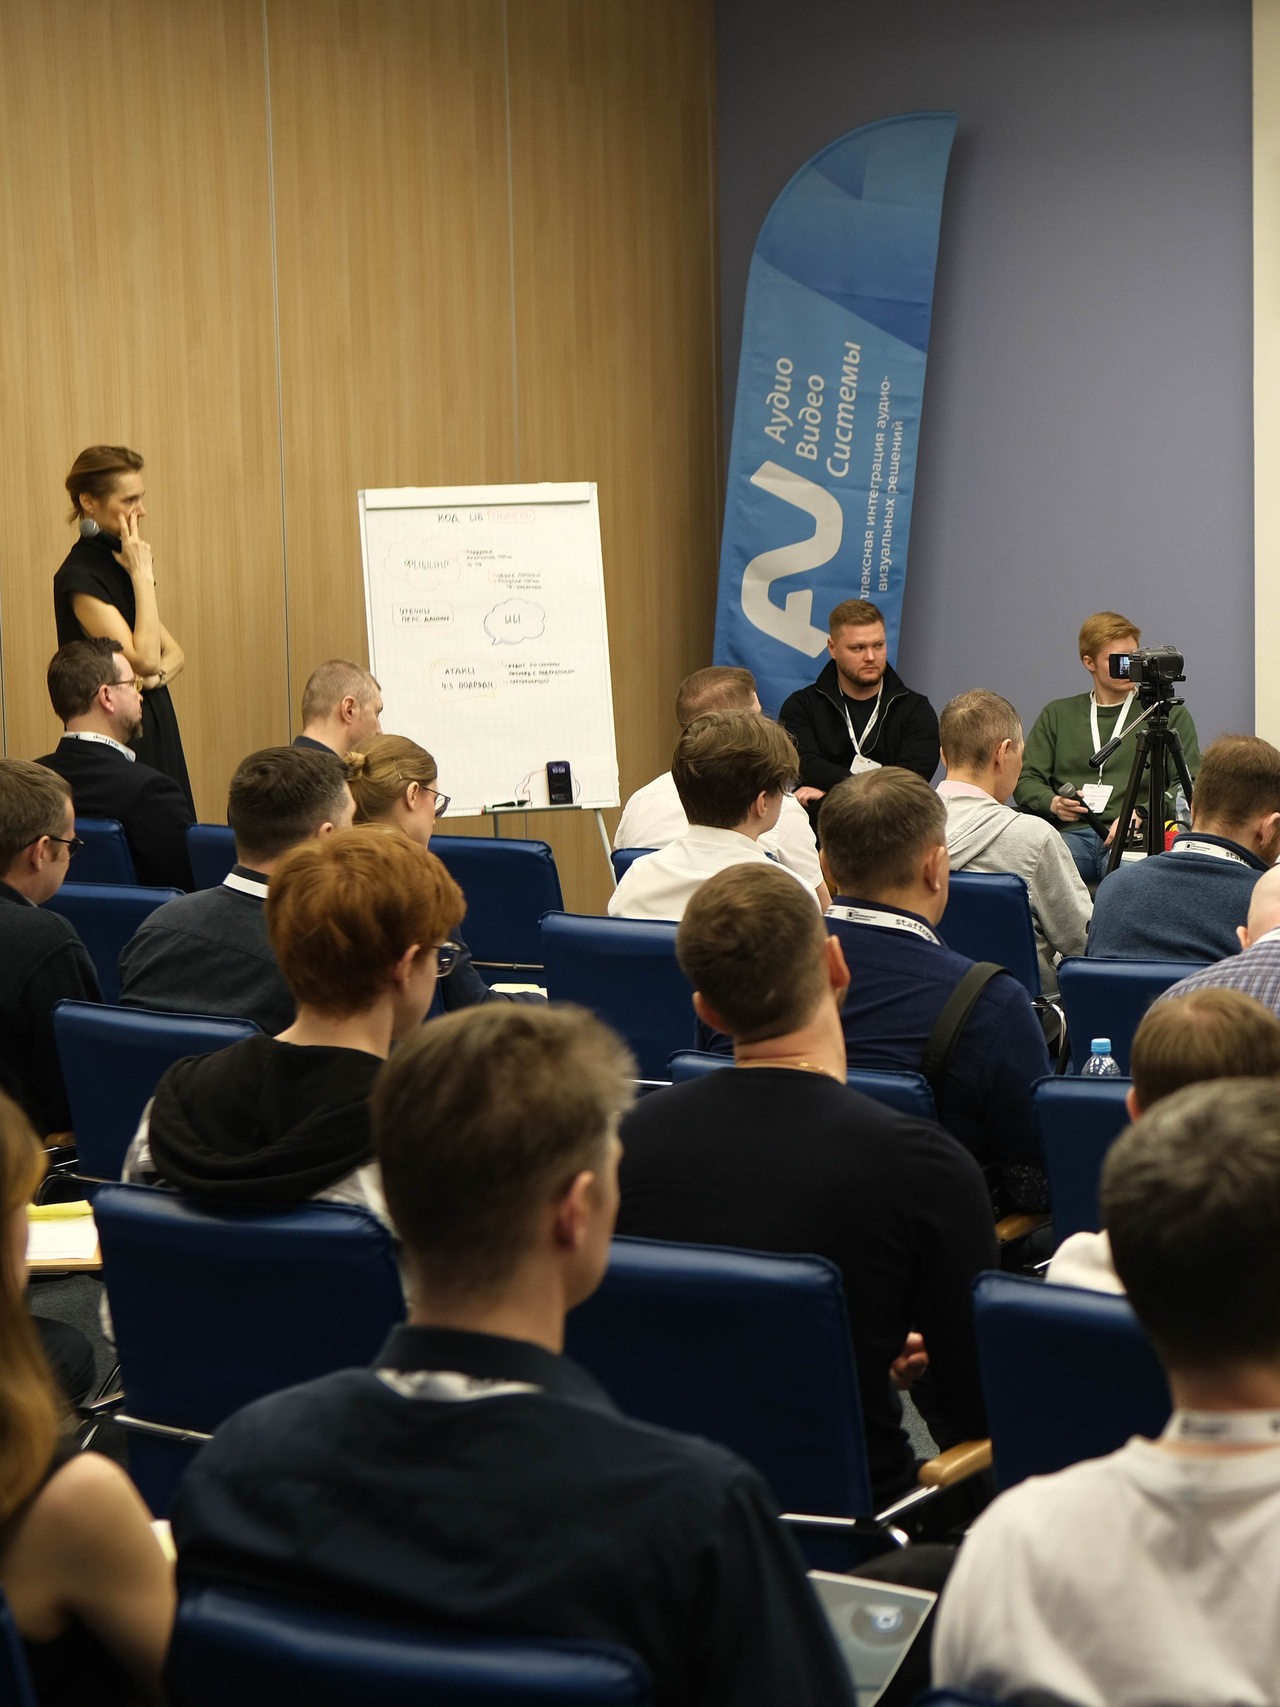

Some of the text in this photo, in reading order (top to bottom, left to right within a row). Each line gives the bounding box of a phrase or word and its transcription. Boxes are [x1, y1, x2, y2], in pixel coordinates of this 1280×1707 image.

[764, 357, 793, 444] Аудио
[795, 374, 825, 460] Видео
[826, 341, 861, 478] Системы
[866, 433, 886, 527] интеграция
[876, 375, 892, 430] аудио-
[878, 421, 904, 592] визуальных решений
[504, 613, 521, 624] ИИ
[445, 667, 475, 676] АТАКИ
